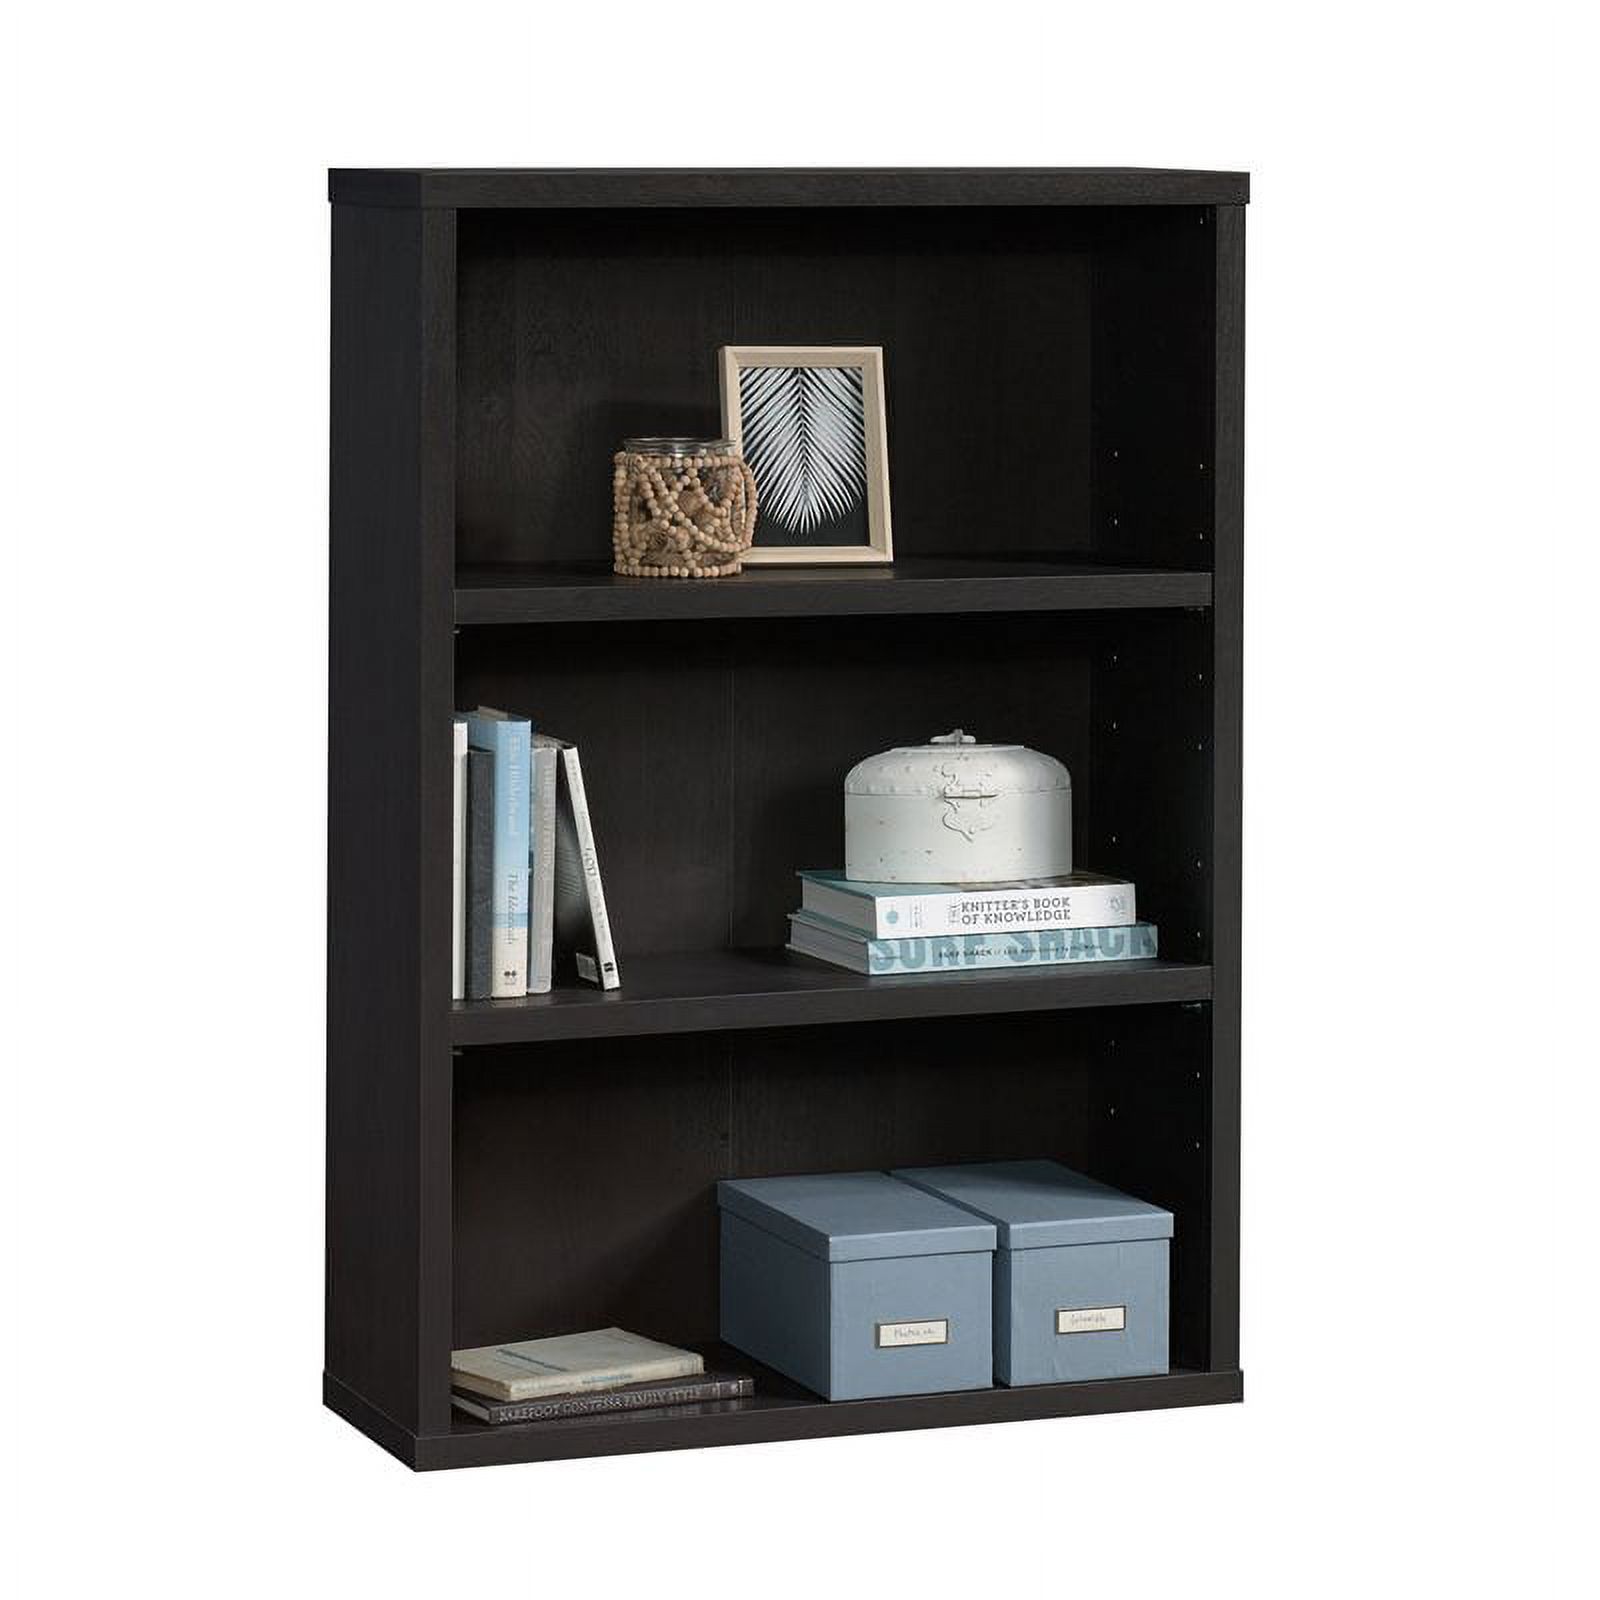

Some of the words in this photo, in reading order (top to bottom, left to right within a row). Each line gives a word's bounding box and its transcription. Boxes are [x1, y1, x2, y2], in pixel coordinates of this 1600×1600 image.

[961, 900, 1029, 912] KNITTER'S
[1034, 897, 1070, 909] BOOK
[962, 913, 979, 925] OF
[984, 910, 1071, 923] KNOWLEDGE
[870, 935, 986, 971] SURF
[1007, 926, 1157, 960] SHACK
